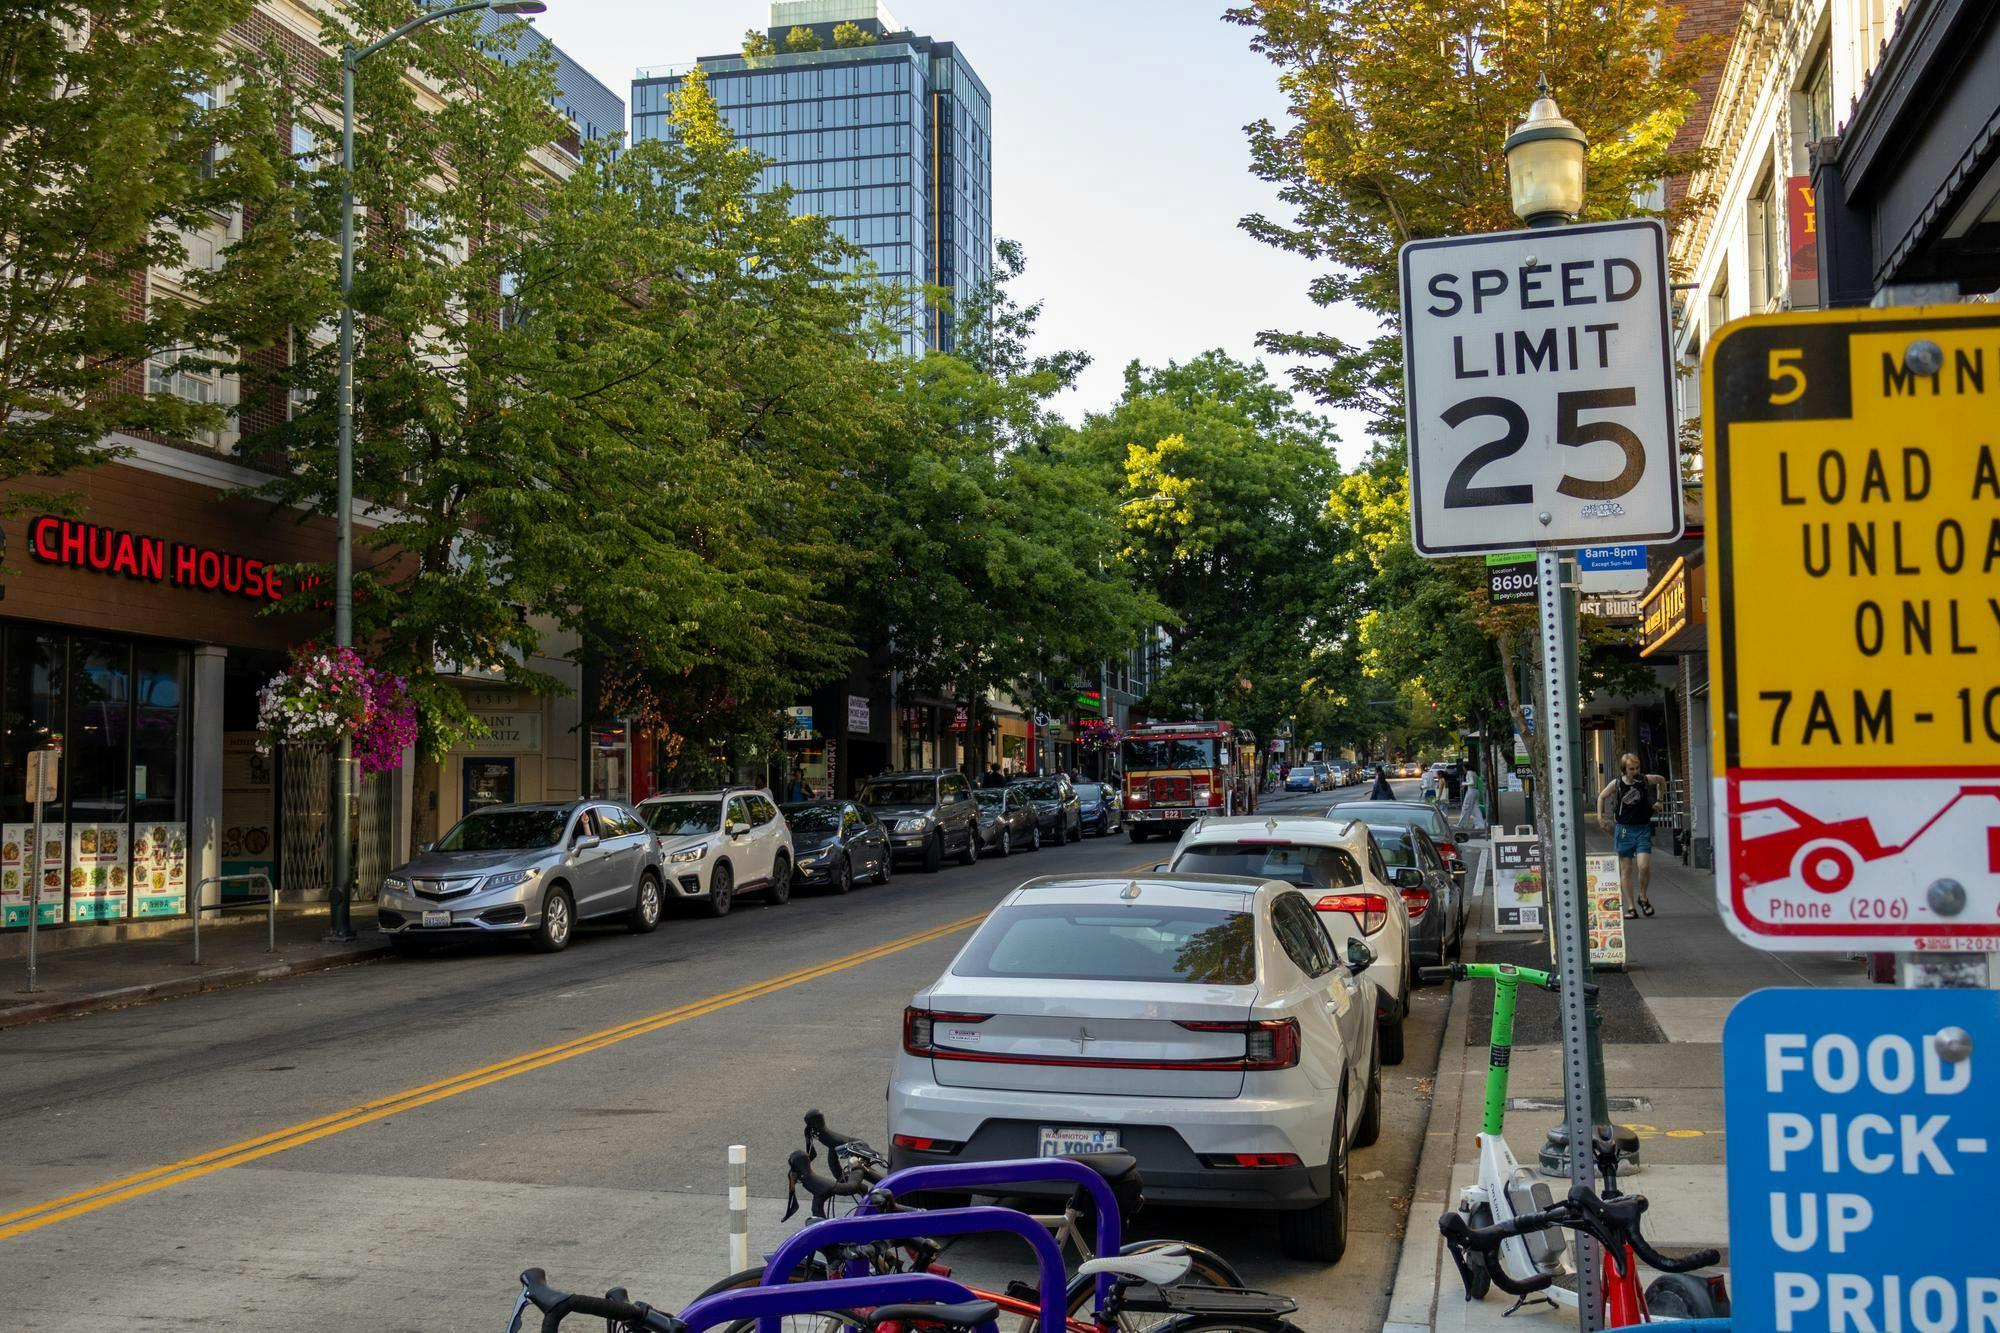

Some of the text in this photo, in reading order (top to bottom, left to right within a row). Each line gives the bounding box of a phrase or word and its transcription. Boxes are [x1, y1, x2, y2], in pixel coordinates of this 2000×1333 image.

[1427, 257, 1642, 318] SPEED
[1453, 322, 1619, 380] LIMIT
[1767, 346, 2000, 405] 5 MN
[1440, 386, 1647, 509] 25
[1779, 445, 1932, 507] LOAD
[34, 516, 164, 580] CHUAN
[174, 543, 282, 600] HOUSE
[1585, 547, 1638, 559] 8am-8pm
[1580, 601, 1642, 616] UST BURGE
[474, 714, 514, 727] AINT
[1164, 810, 1179, 818] E22
[1504, 845, 1518, 853] NEW
[1770, 898, 1831, 918] Phone
[1764, 1033, 1973, 1095] FOOD
[1045, 1132, 1089, 1140] WASHINGTON
[1767, 1111, 1987, 1175] PICK-
[1769, 1191, 1874, 1253] UP
[1773, 1271, 2000, 1333] PRIOR
